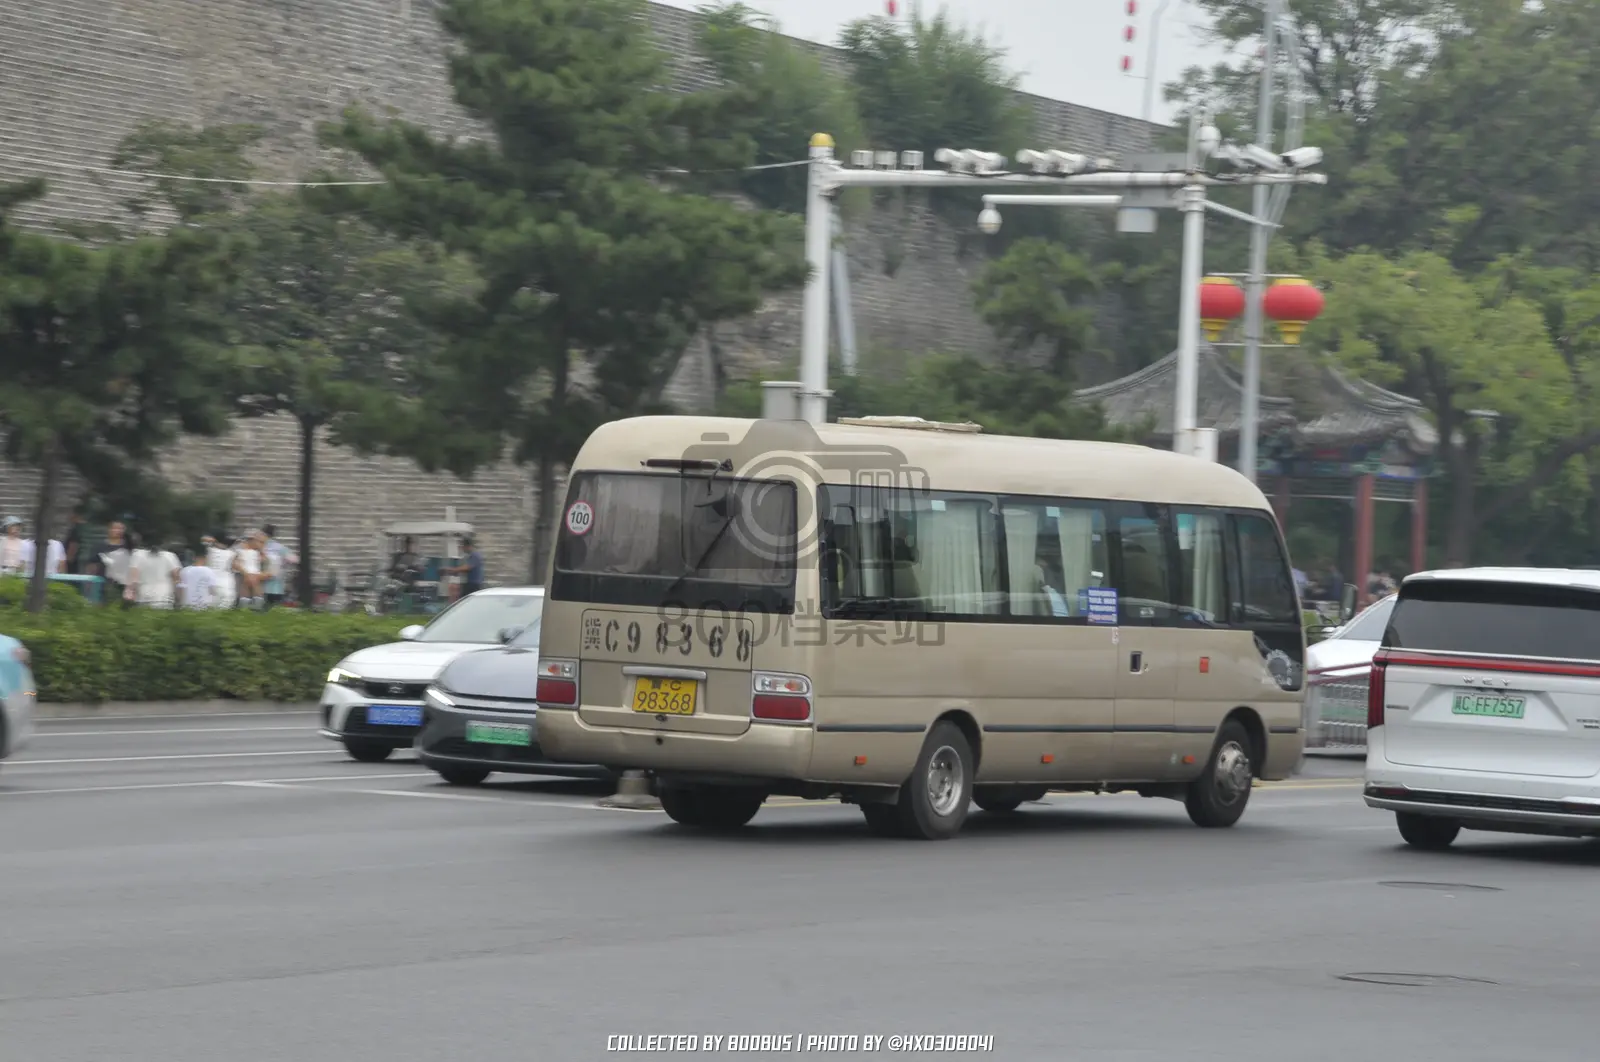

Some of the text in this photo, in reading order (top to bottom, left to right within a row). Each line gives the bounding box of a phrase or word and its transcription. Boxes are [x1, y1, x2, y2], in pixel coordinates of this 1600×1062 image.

[571, 511, 590, 526] 100
[1462, 676, 1511, 686] WEY
[637, 690, 691, 711] 98368
